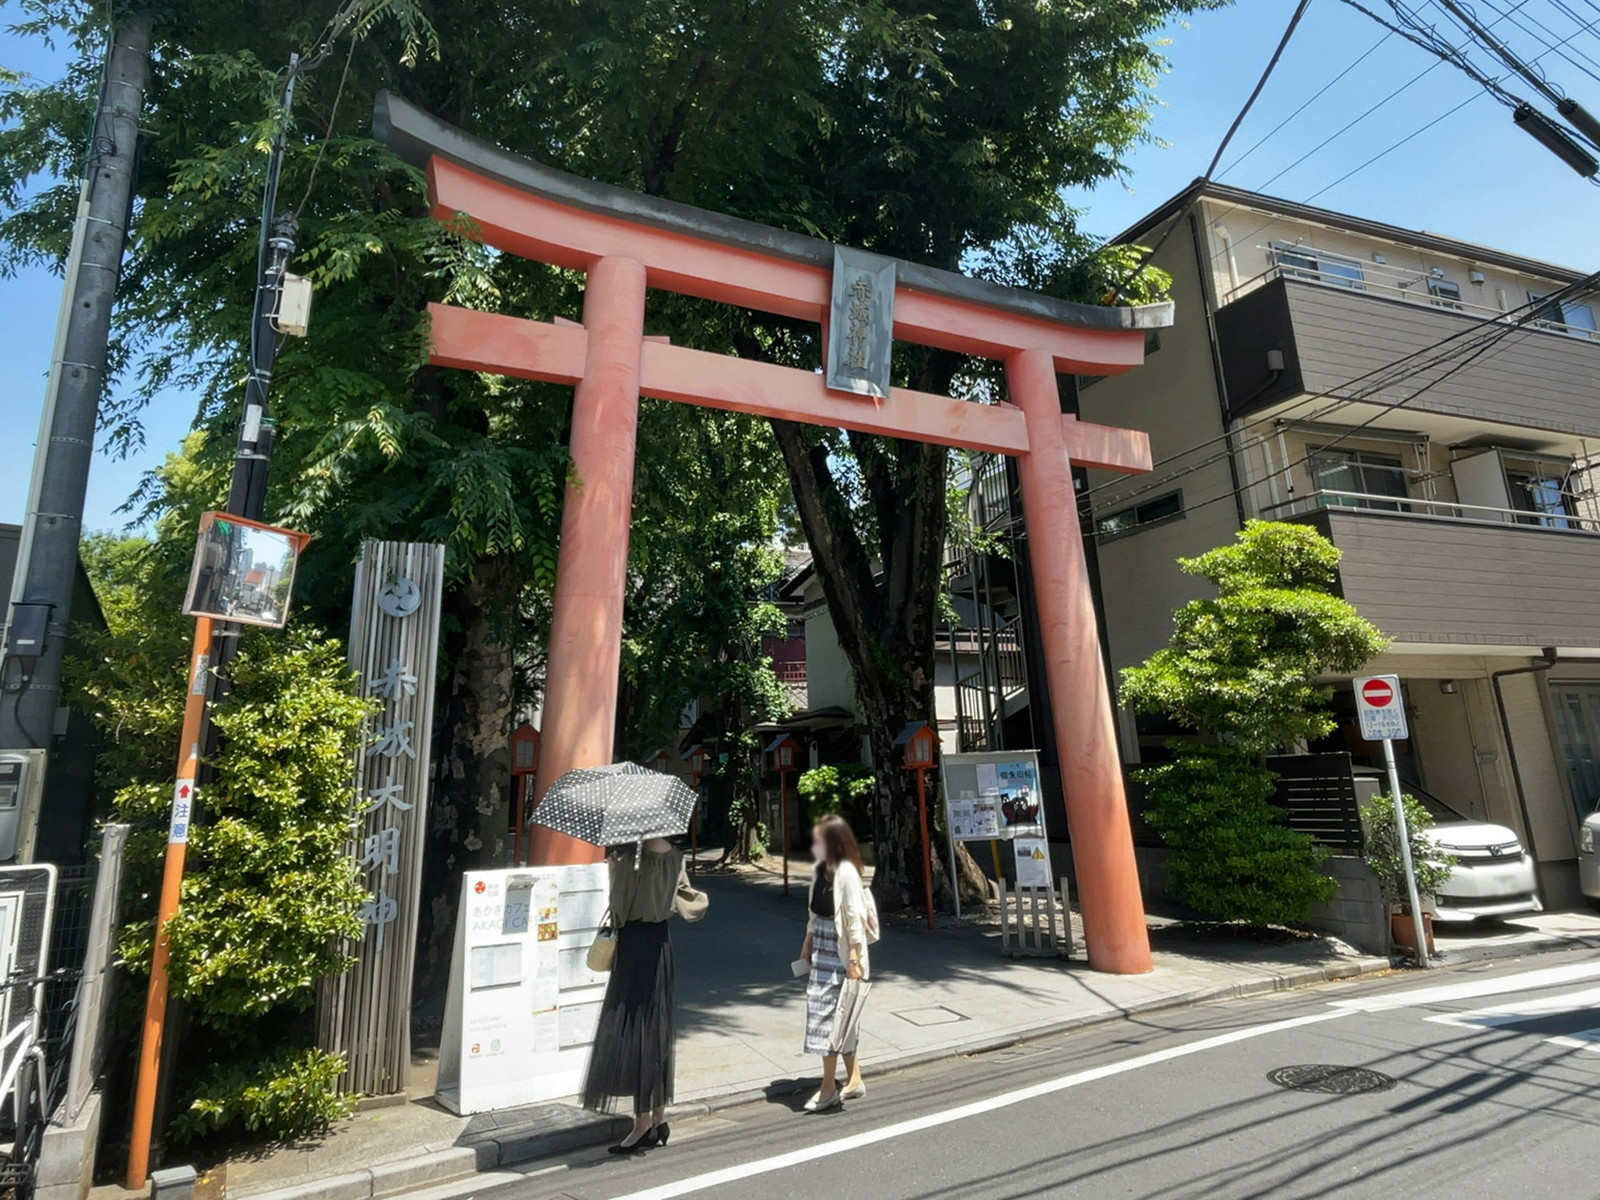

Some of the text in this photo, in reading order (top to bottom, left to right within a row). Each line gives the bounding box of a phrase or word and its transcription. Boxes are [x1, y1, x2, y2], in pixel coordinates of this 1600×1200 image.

[842, 275, 871, 369] 赤城神社
[173, 803, 189, 838] 注意
[356, 657, 418, 951] 赤城大明神
